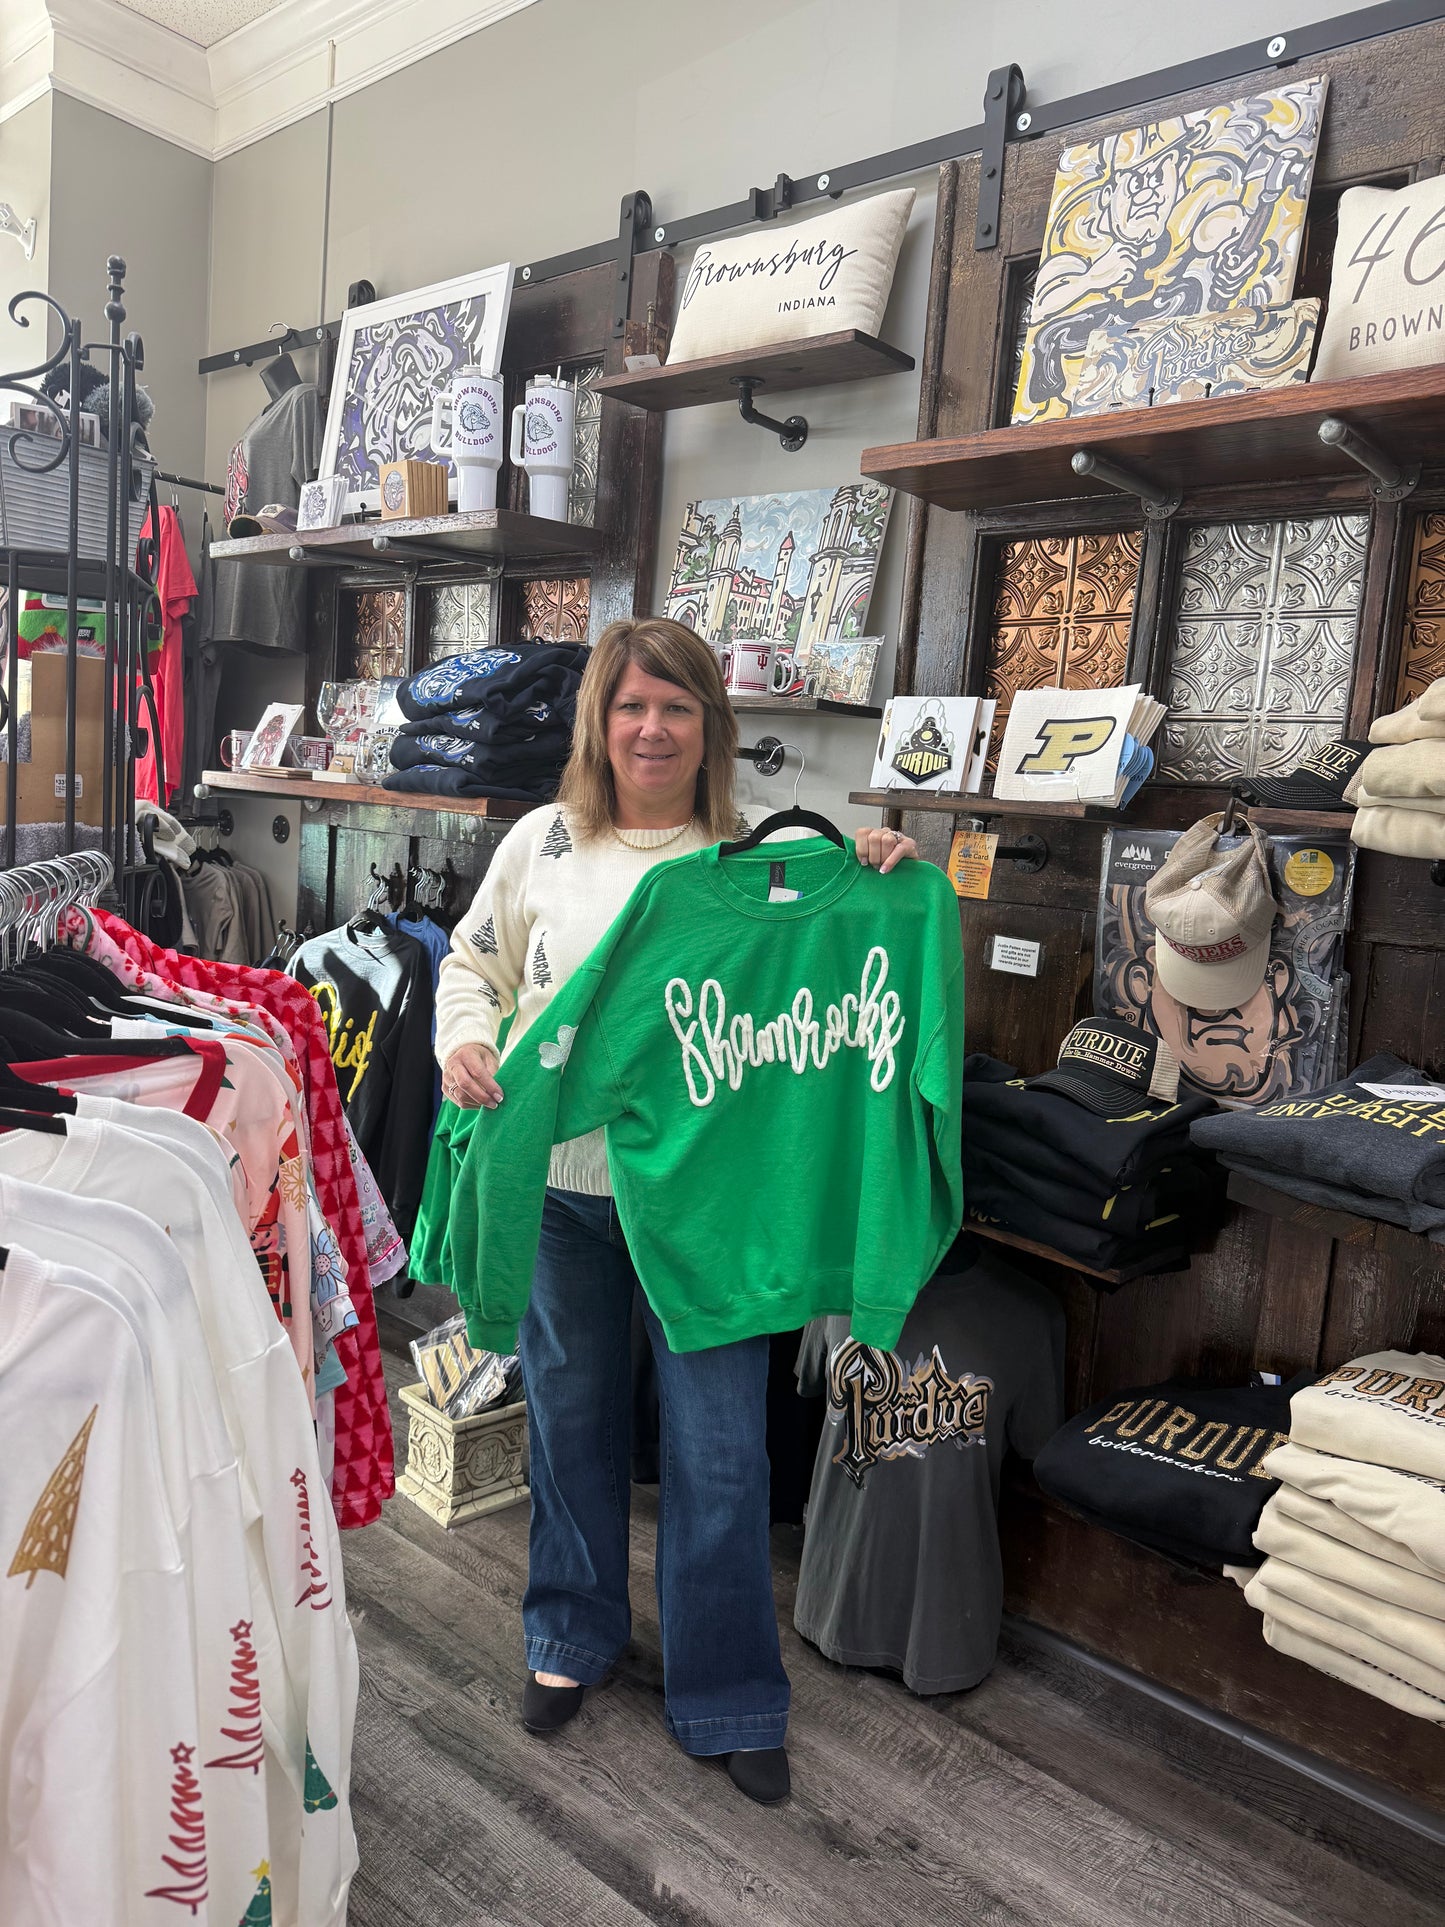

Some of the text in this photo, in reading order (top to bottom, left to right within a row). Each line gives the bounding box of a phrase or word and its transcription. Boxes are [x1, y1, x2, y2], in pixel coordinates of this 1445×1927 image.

[683, 239, 858, 310] Brownsburg
[778, 296, 836, 312] INDIANA
[1350, 304, 1444, 351] BROWN
[1137, 321, 1256, 396] Purdue
[453, 386, 498, 415] BROWNSBURG
[454, 430, 494, 446] BULLDOGS
[895, 751, 949, 776] PURDUE
[1014, 716, 1117, 775] P
[973, 853, 989, 861] Card
[1114, 861, 1157, 871] evergreen
[664, 945, 906, 1107] Shamrocks
[1067, 1030, 1148, 1068] PURDUE
[1115, 1062, 1137, 1076] Down
[830, 1340, 992, 1489] Purdue
[1312, 1366, 1445, 1419] PUR
[1083, 1398, 1290, 1480] PURDUE
[1088, 1435, 1245, 1483] boilermakers
